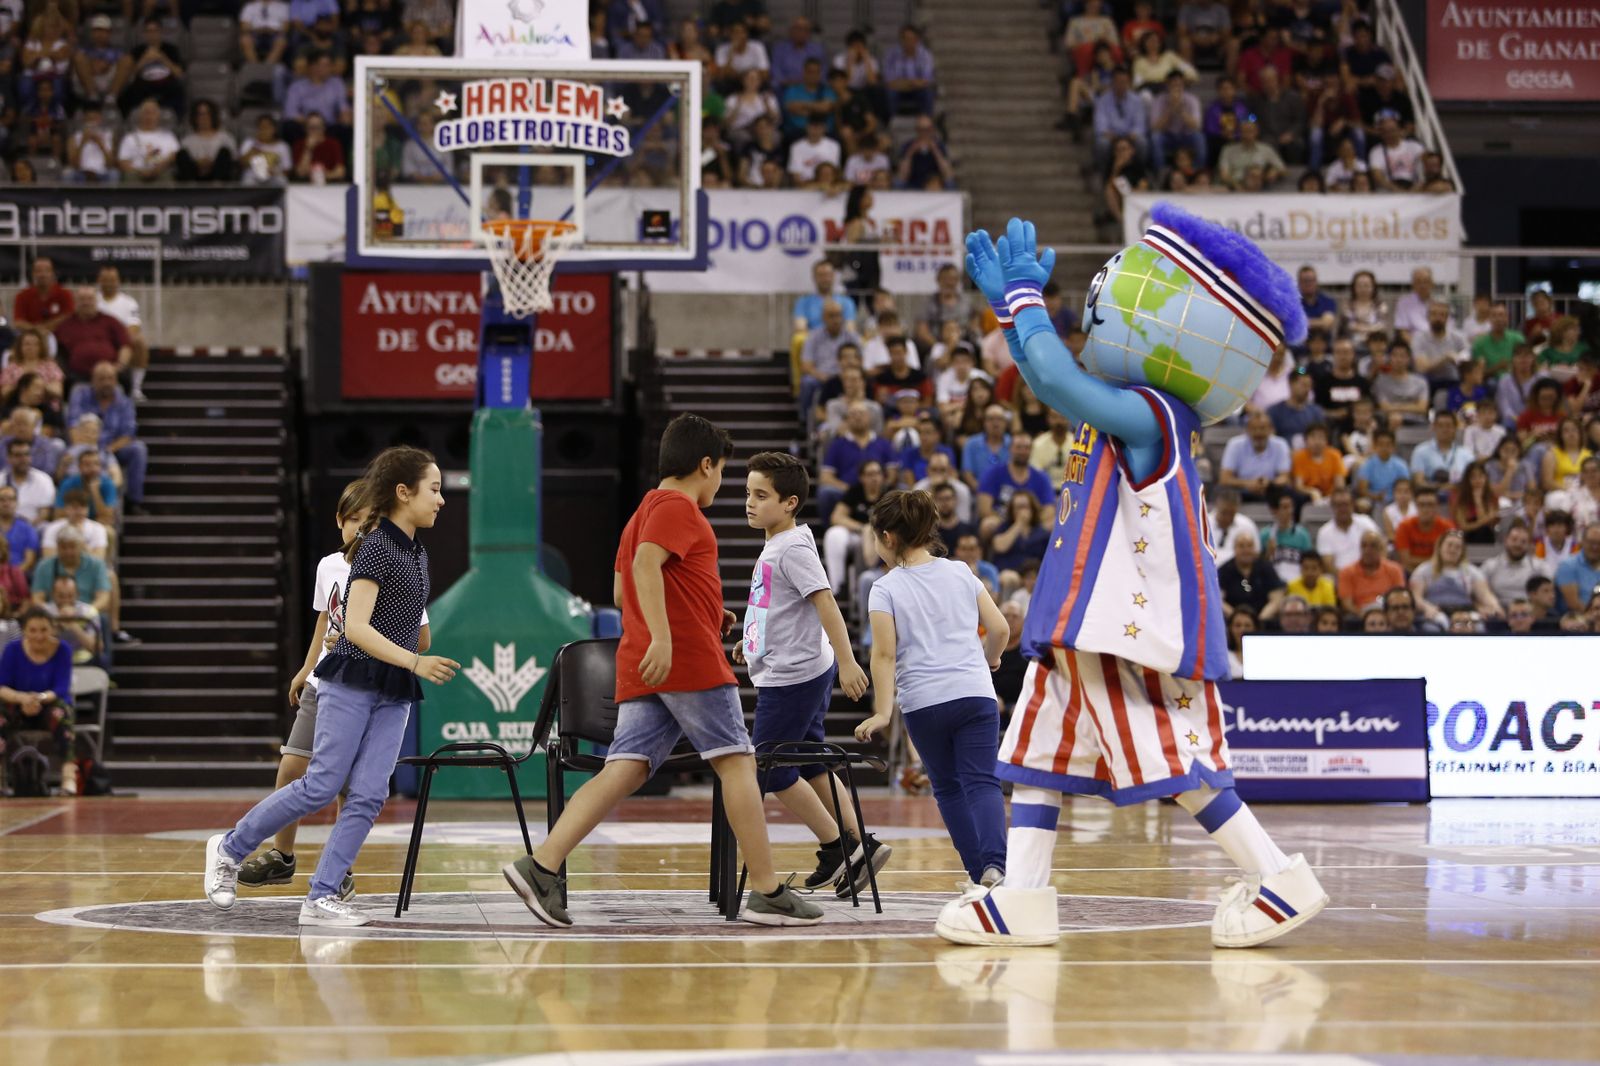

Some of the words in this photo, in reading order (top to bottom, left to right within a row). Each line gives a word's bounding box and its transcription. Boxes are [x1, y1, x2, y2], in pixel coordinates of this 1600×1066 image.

[1457, 40, 1491, 60] DE
[465, 80, 600, 121] HARLEM
[437, 118, 626, 154] GLOBETROTTERS
[377, 328, 418, 351] DE
[426, 319, 574, 351] GRDA
[441, 721, 492, 740] CAJA
